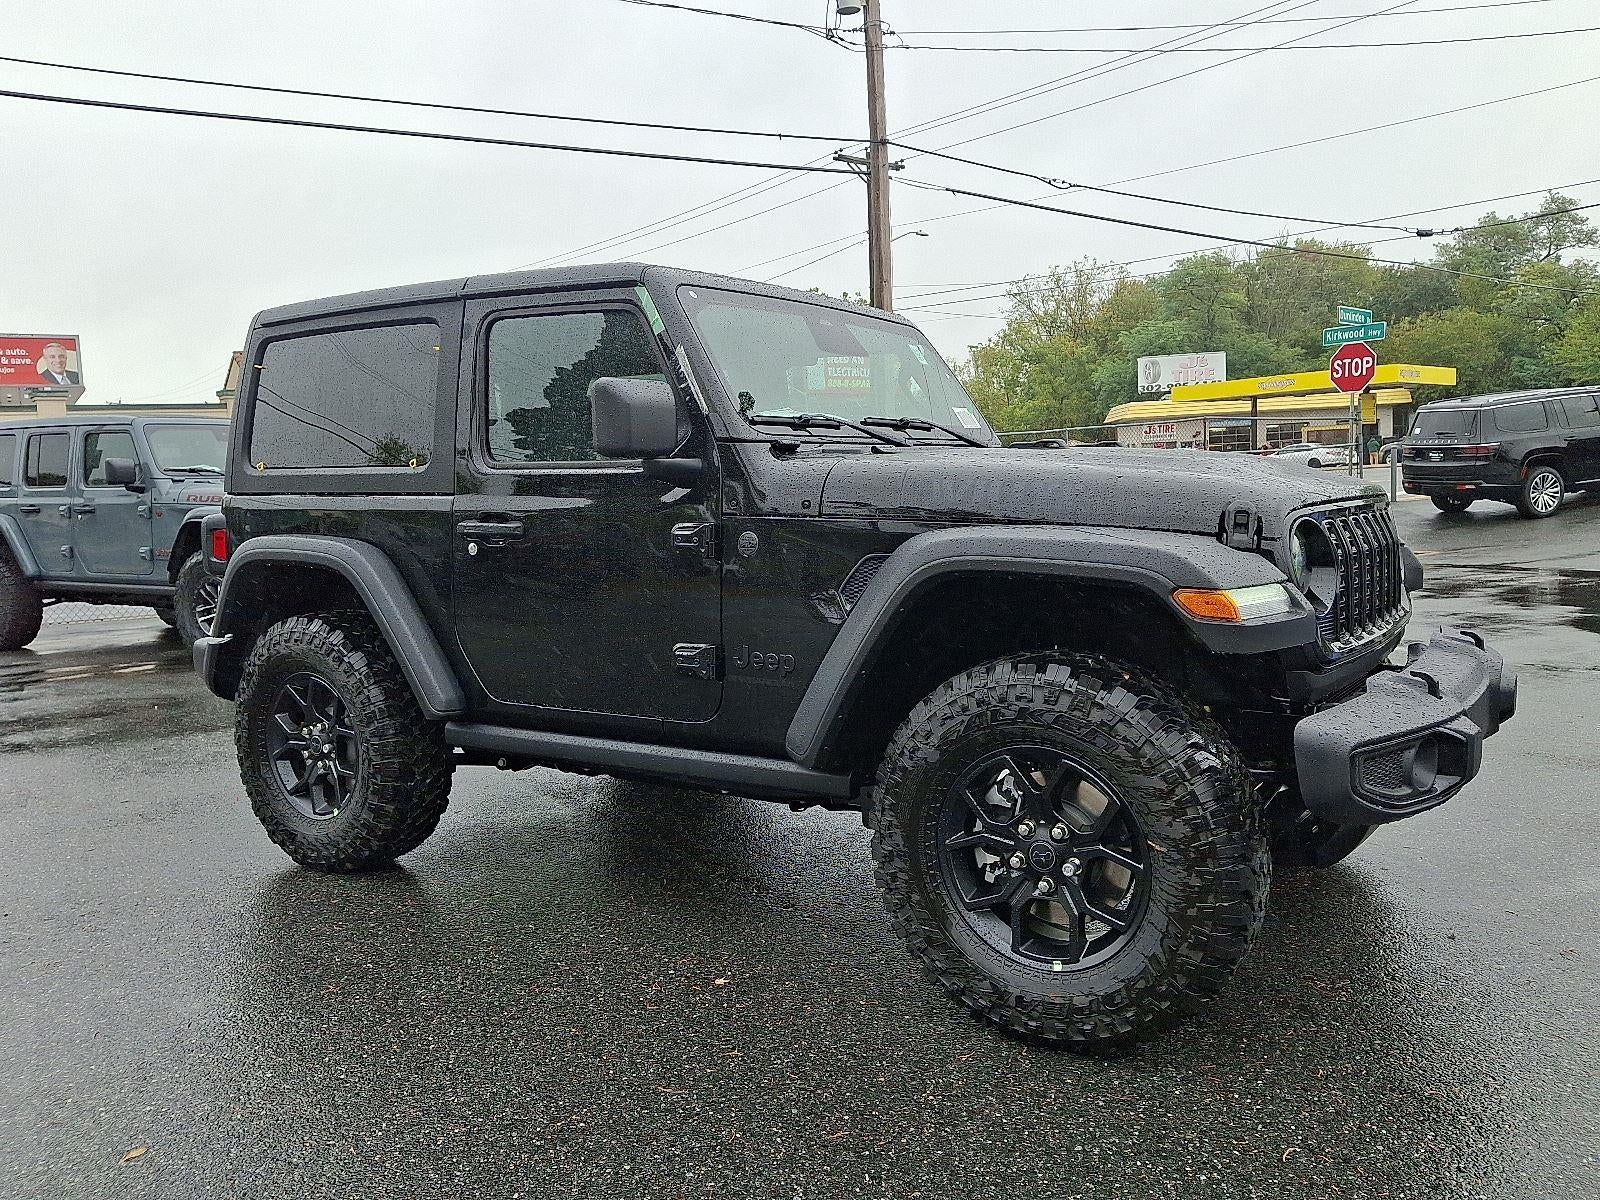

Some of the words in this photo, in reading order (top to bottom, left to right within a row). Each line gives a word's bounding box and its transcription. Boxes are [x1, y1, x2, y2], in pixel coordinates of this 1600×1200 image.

[1326, 327, 1365, 342] Kirkwood
[1368, 329, 1382, 337] Hwy
[5, 348, 29, 356] auto.
[1, 356, 9, 365] &
[11, 357, 34, 365] save.
[0, 366, 15, 375] ujos
[1332, 356, 1373, 379] STOP
[1171, 368, 1215, 382] TIRE
[1157, 424, 1175, 434] TIRE
[187, 494, 222, 502] RUB
[733, 645, 796, 680] Jeep
